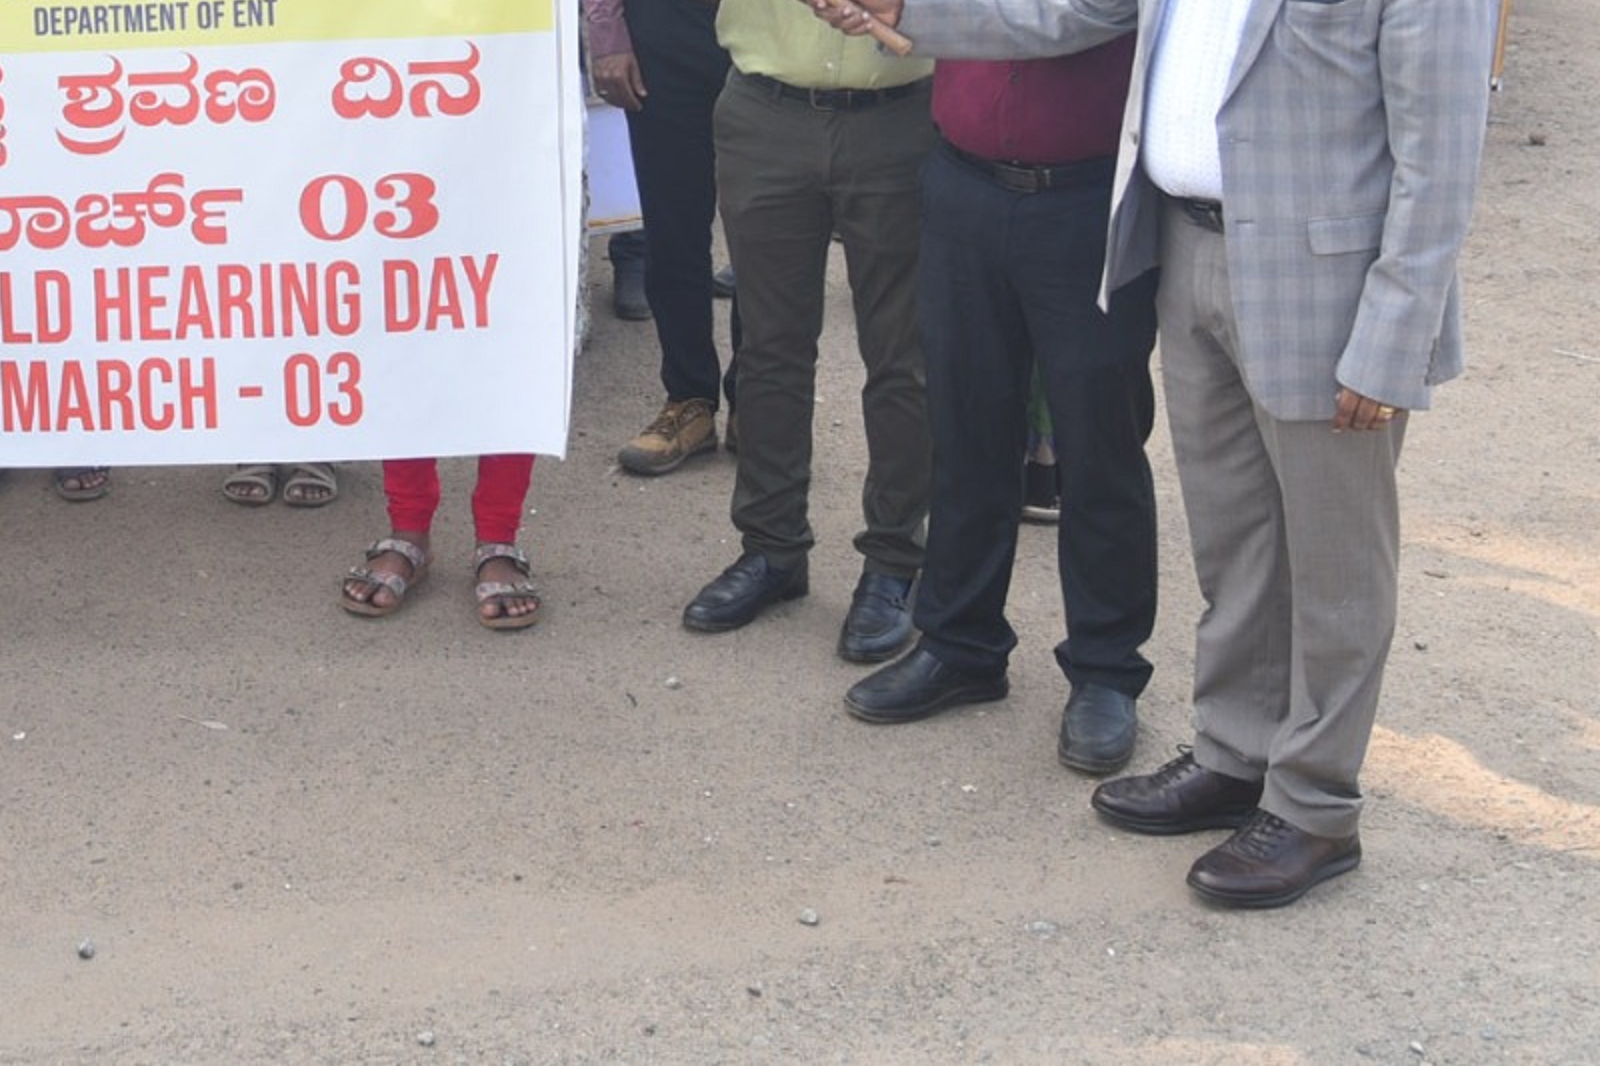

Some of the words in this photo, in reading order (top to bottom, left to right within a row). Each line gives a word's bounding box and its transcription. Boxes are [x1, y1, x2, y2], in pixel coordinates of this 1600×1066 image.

[34, 0, 189, 36] DEPARTMENT
[195, 0, 225, 30] OF
[56, 51, 277, 156] ಶ್ರವಣ
[330, 40, 482, 121] ದಿನ
[298, 171, 440, 242] 03
[94, 258, 361, 342] HEARING
[381, 253, 500, 334] DAY
[0, 355, 217, 434] MARCH
[283, 352, 364, 427] 03
